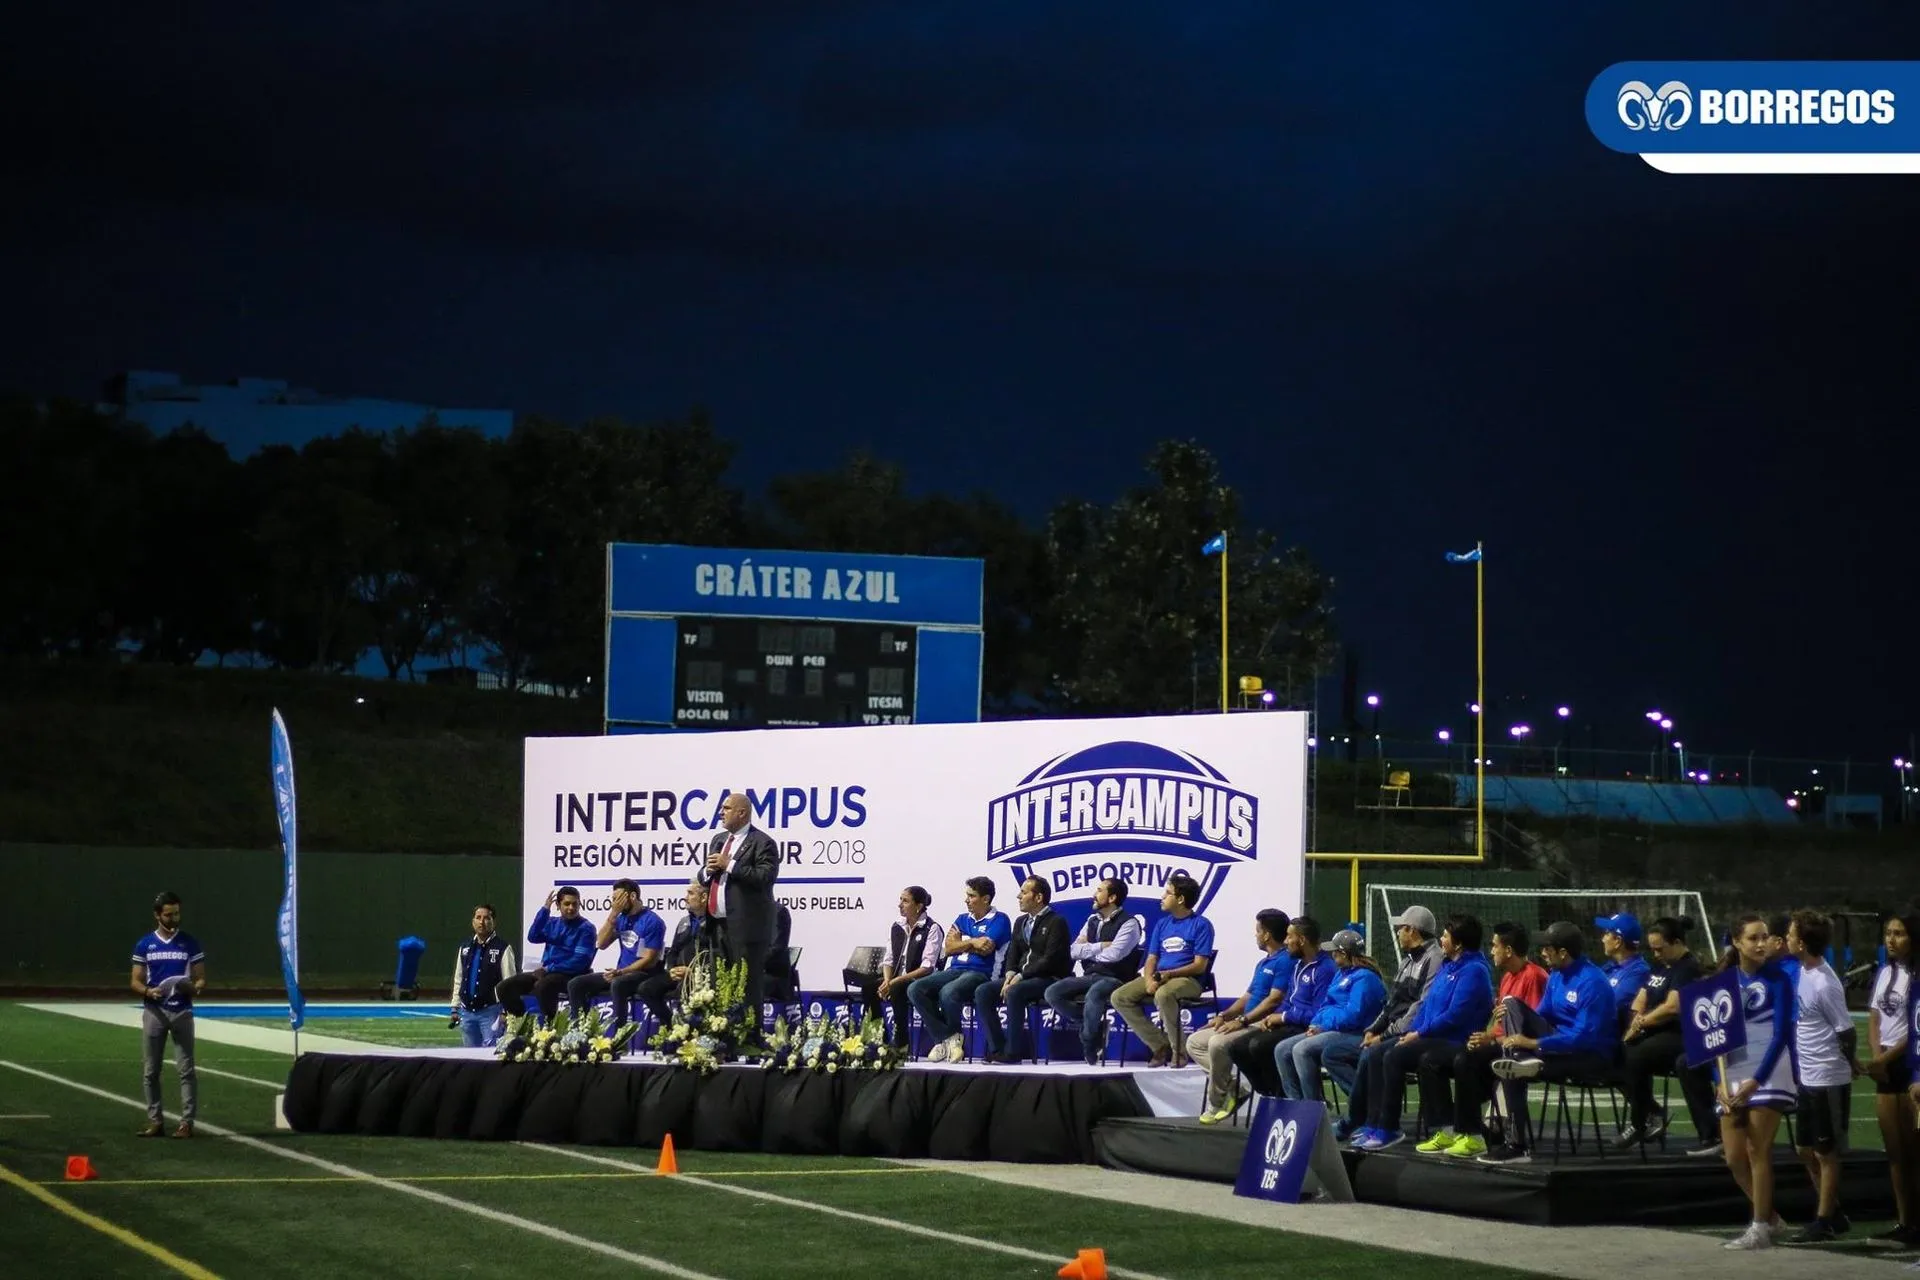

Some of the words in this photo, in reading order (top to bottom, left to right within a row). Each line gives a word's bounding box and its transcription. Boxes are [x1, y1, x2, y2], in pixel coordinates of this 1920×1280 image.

[695, 558, 812, 599] CRÁTER
[822, 568, 900, 603] AZUL
[686, 690, 724, 703] VISITA
[868, 696, 903, 708] ITESM
[677, 709, 710, 720] BOLA
[992, 778, 1253, 855] INTERCAMPUS
[554, 838, 642, 868] REGIÓN
[651, 837, 708, 866] MÉXI
[812, 840, 866, 864] 2018
[811, 897, 864, 910] PUEBLA
[1705, 1029, 1726, 1049] CHS
[1261, 1169, 1278, 1189] TEC
